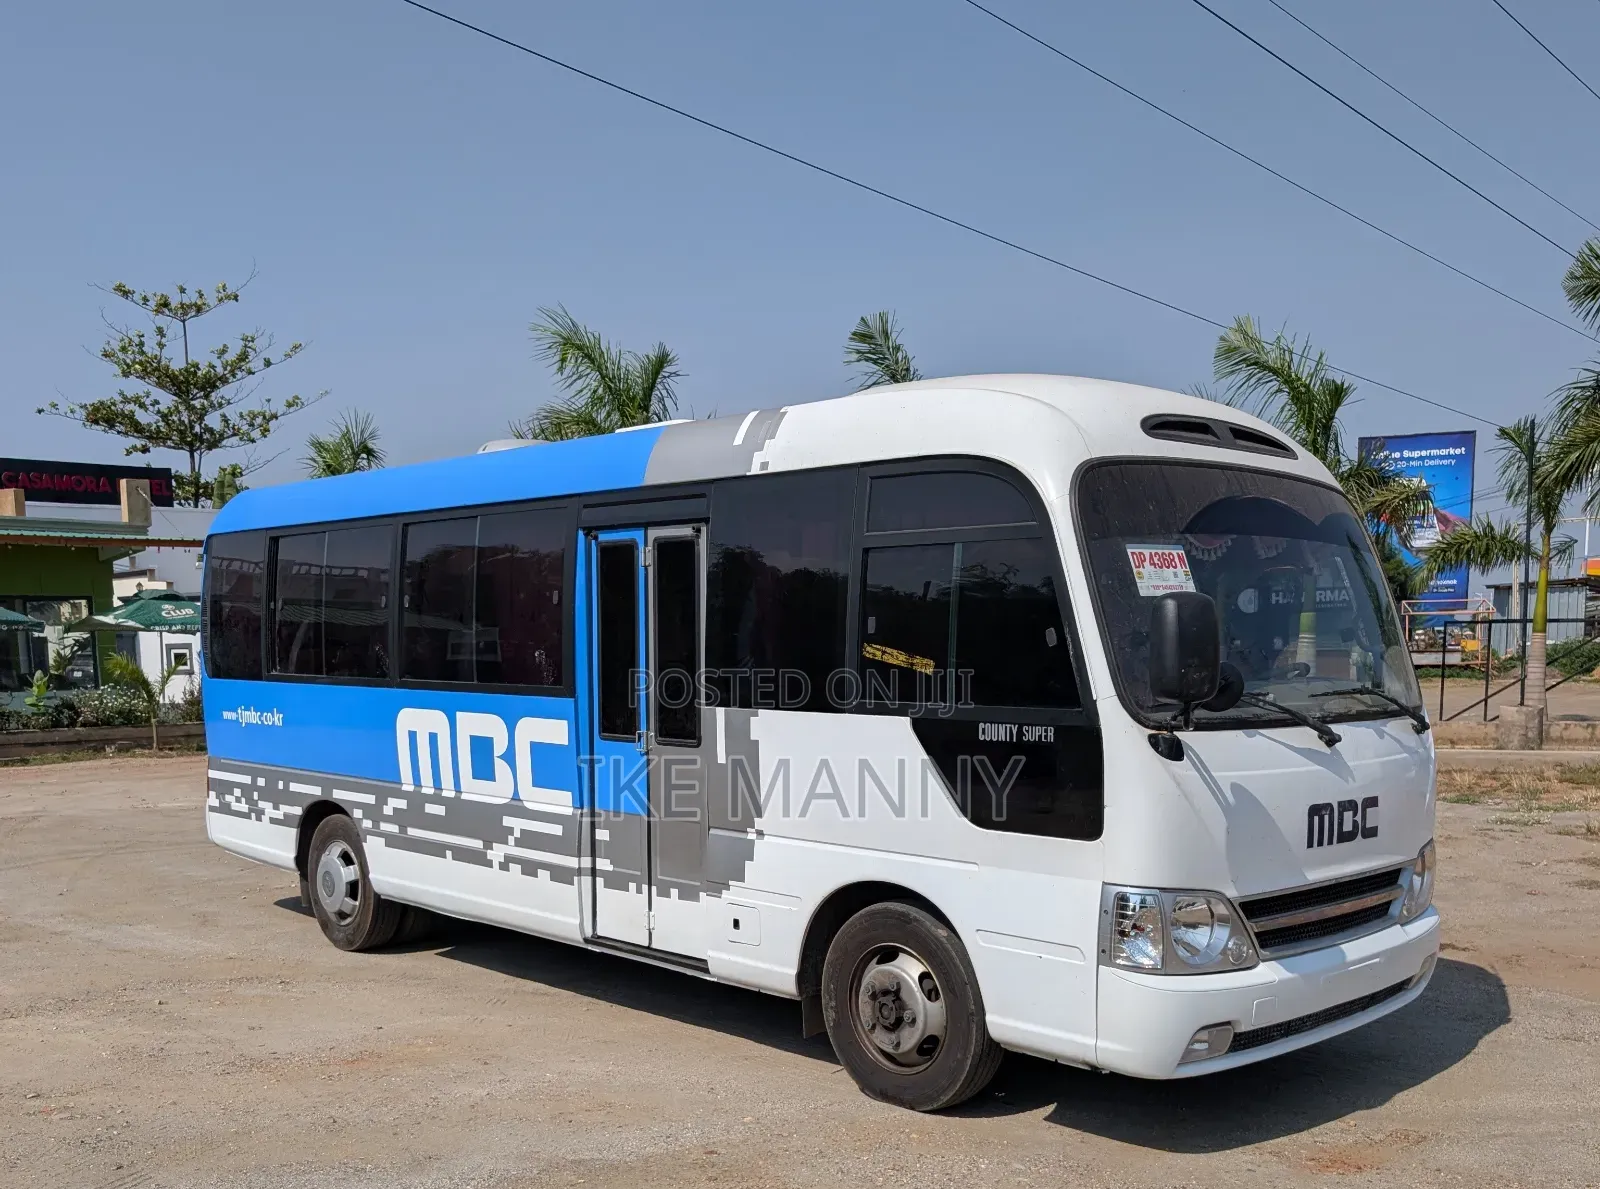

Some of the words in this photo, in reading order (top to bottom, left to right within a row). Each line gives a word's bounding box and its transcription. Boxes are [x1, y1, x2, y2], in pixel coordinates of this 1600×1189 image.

[1396, 459, 1423, 468] 20-Min
[1424, 458, 1456, 467] Delivery
[1403, 446, 1466, 459] Supermarket
[1, 471, 112, 493] CASAMORA
[1130, 551, 1147, 569] DP
[1148, 551, 1178, 569] 4368
[1176, 552, 1189, 570] N
[161, 608, 195, 617] CLUB
[222, 705, 284, 727] www.tjmbc.co.kr
[978, 722, 1019, 742] COUNTY
[1022, 725, 1055, 743] SUPER
[396, 707, 573, 816] MBC
[1306, 796, 1379, 849] MBC
